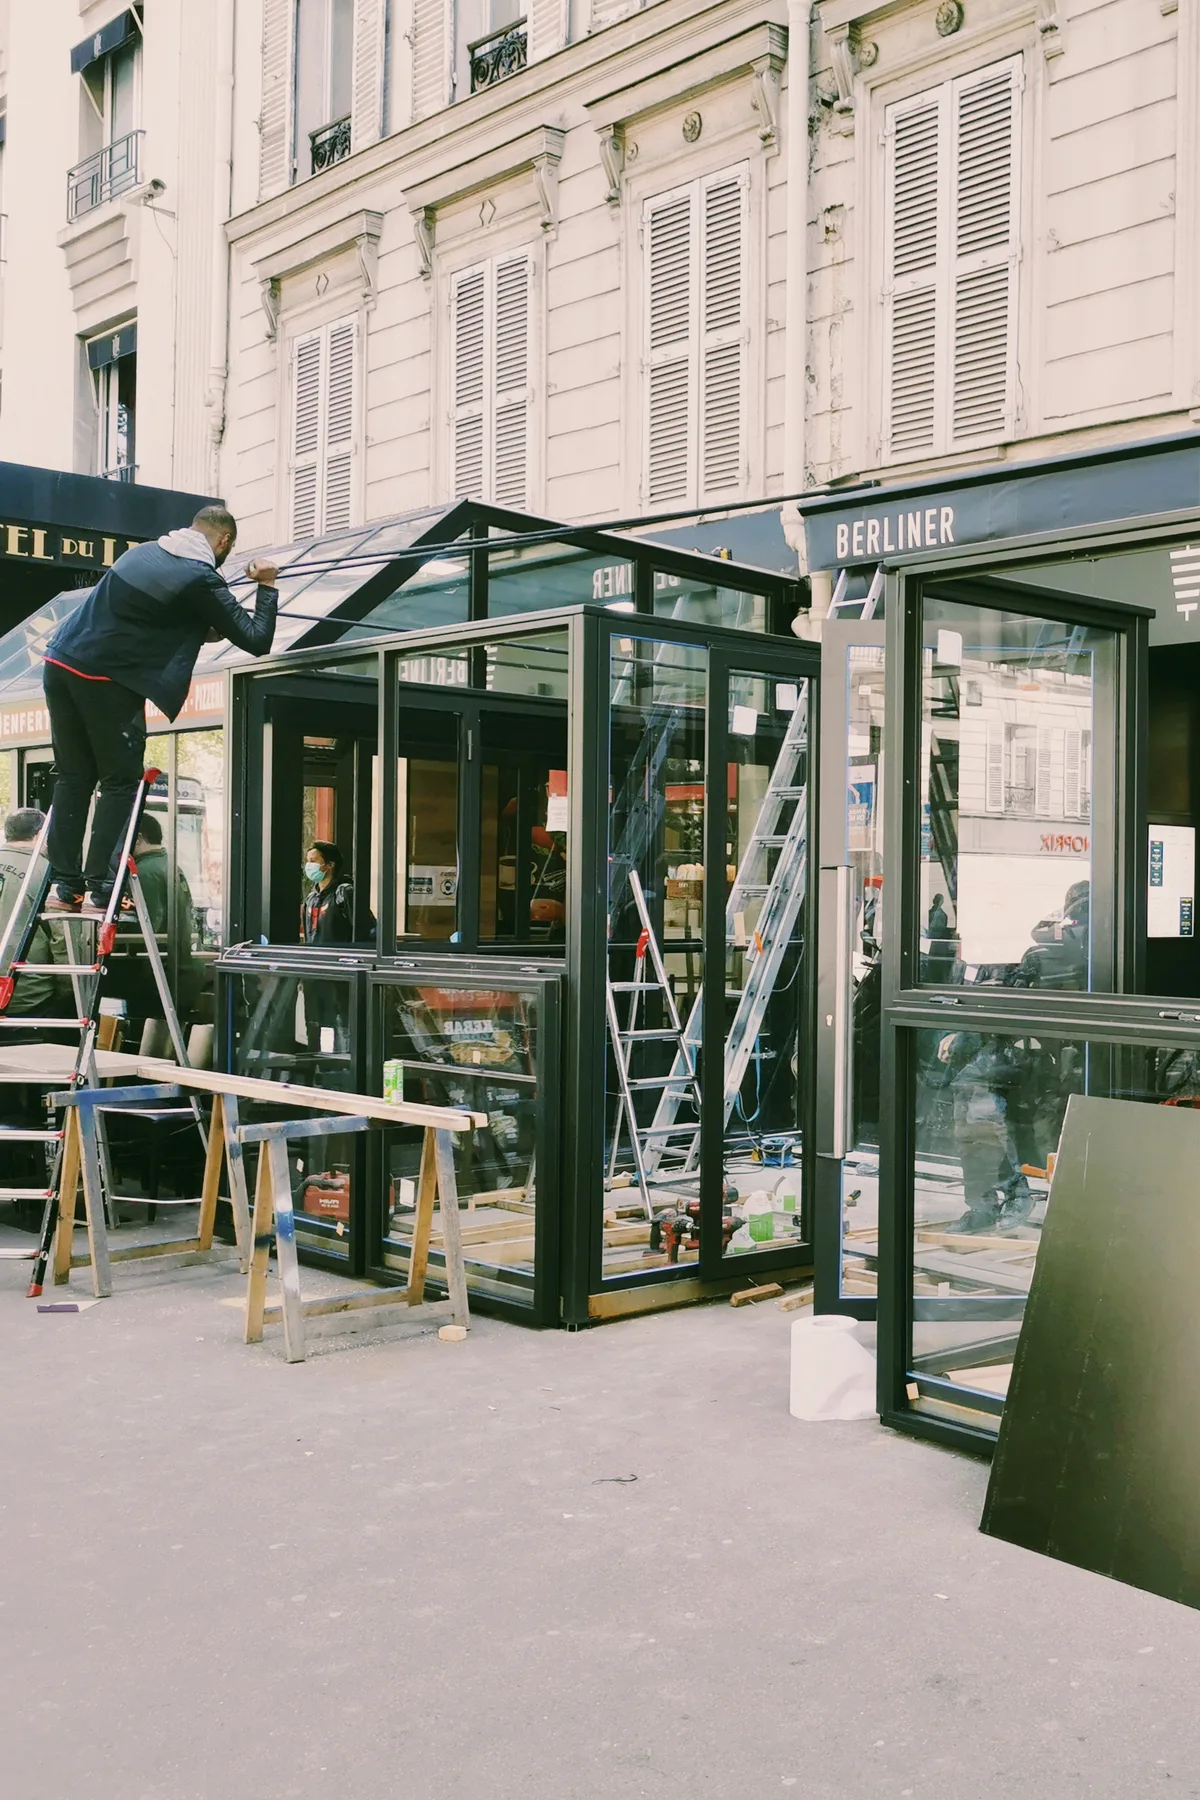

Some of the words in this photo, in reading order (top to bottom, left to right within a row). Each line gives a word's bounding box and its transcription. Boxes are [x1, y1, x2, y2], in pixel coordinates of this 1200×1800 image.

[0, 523, 54, 560] EL
[62, 537, 94, 558] DU
[836, 506, 954, 559] BERLINER
[0, 708, 50, 735] ENFERT
